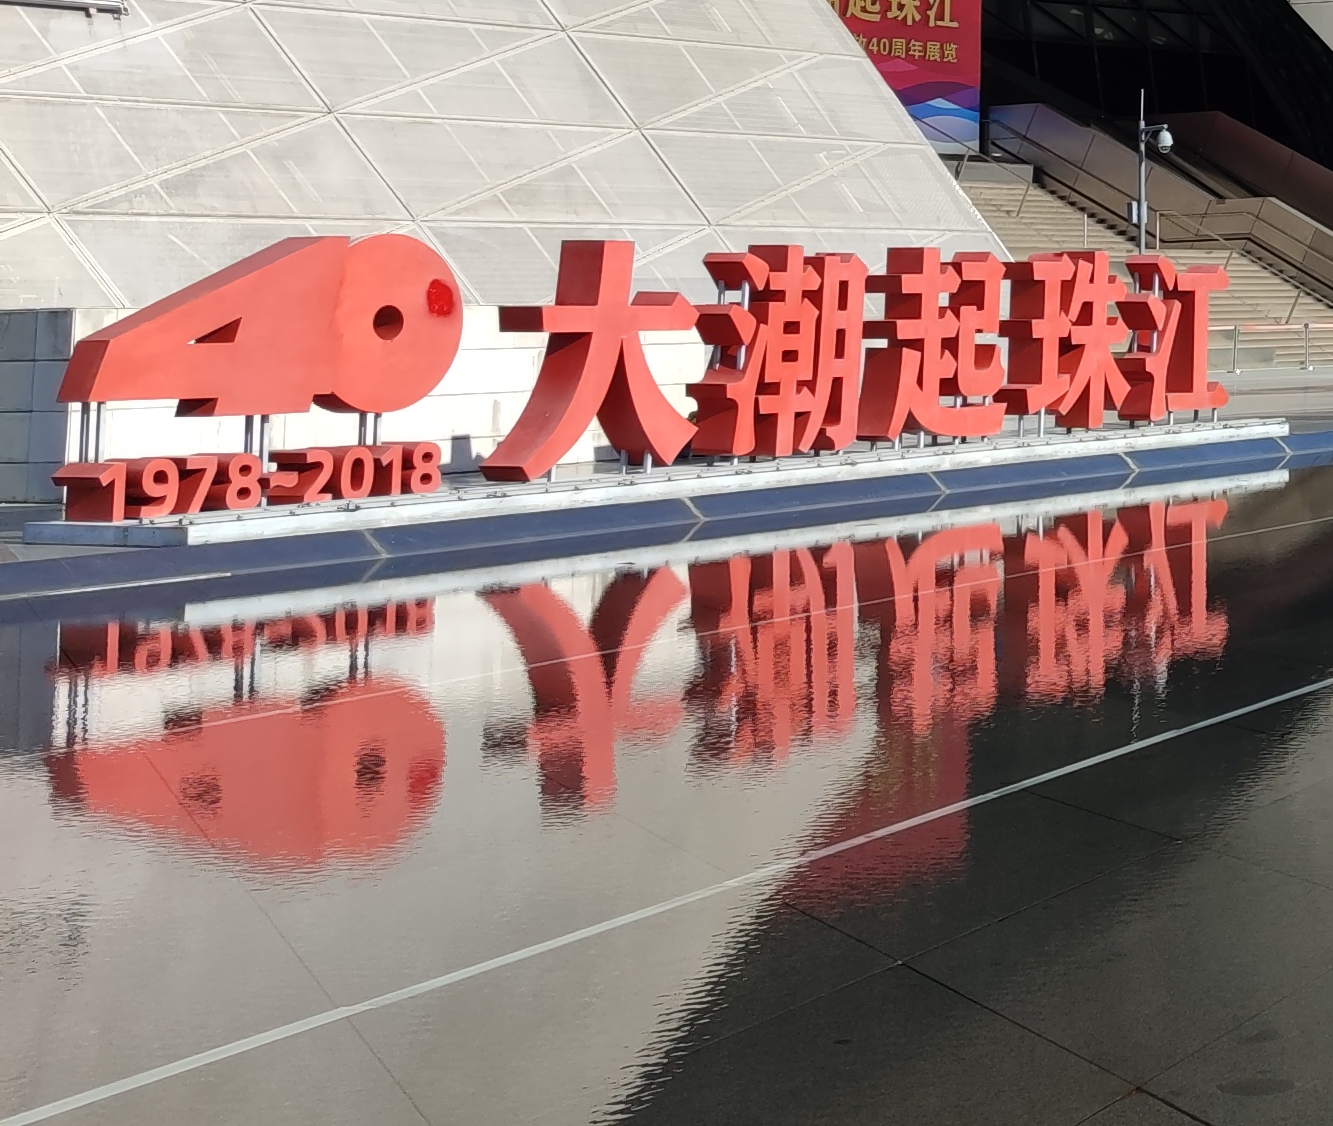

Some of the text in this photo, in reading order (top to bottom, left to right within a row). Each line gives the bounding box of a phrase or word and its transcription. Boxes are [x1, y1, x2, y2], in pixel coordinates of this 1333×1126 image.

[57, 234, 463, 417] 40
[480, 240, 1229, 482] 大潮起珠江
